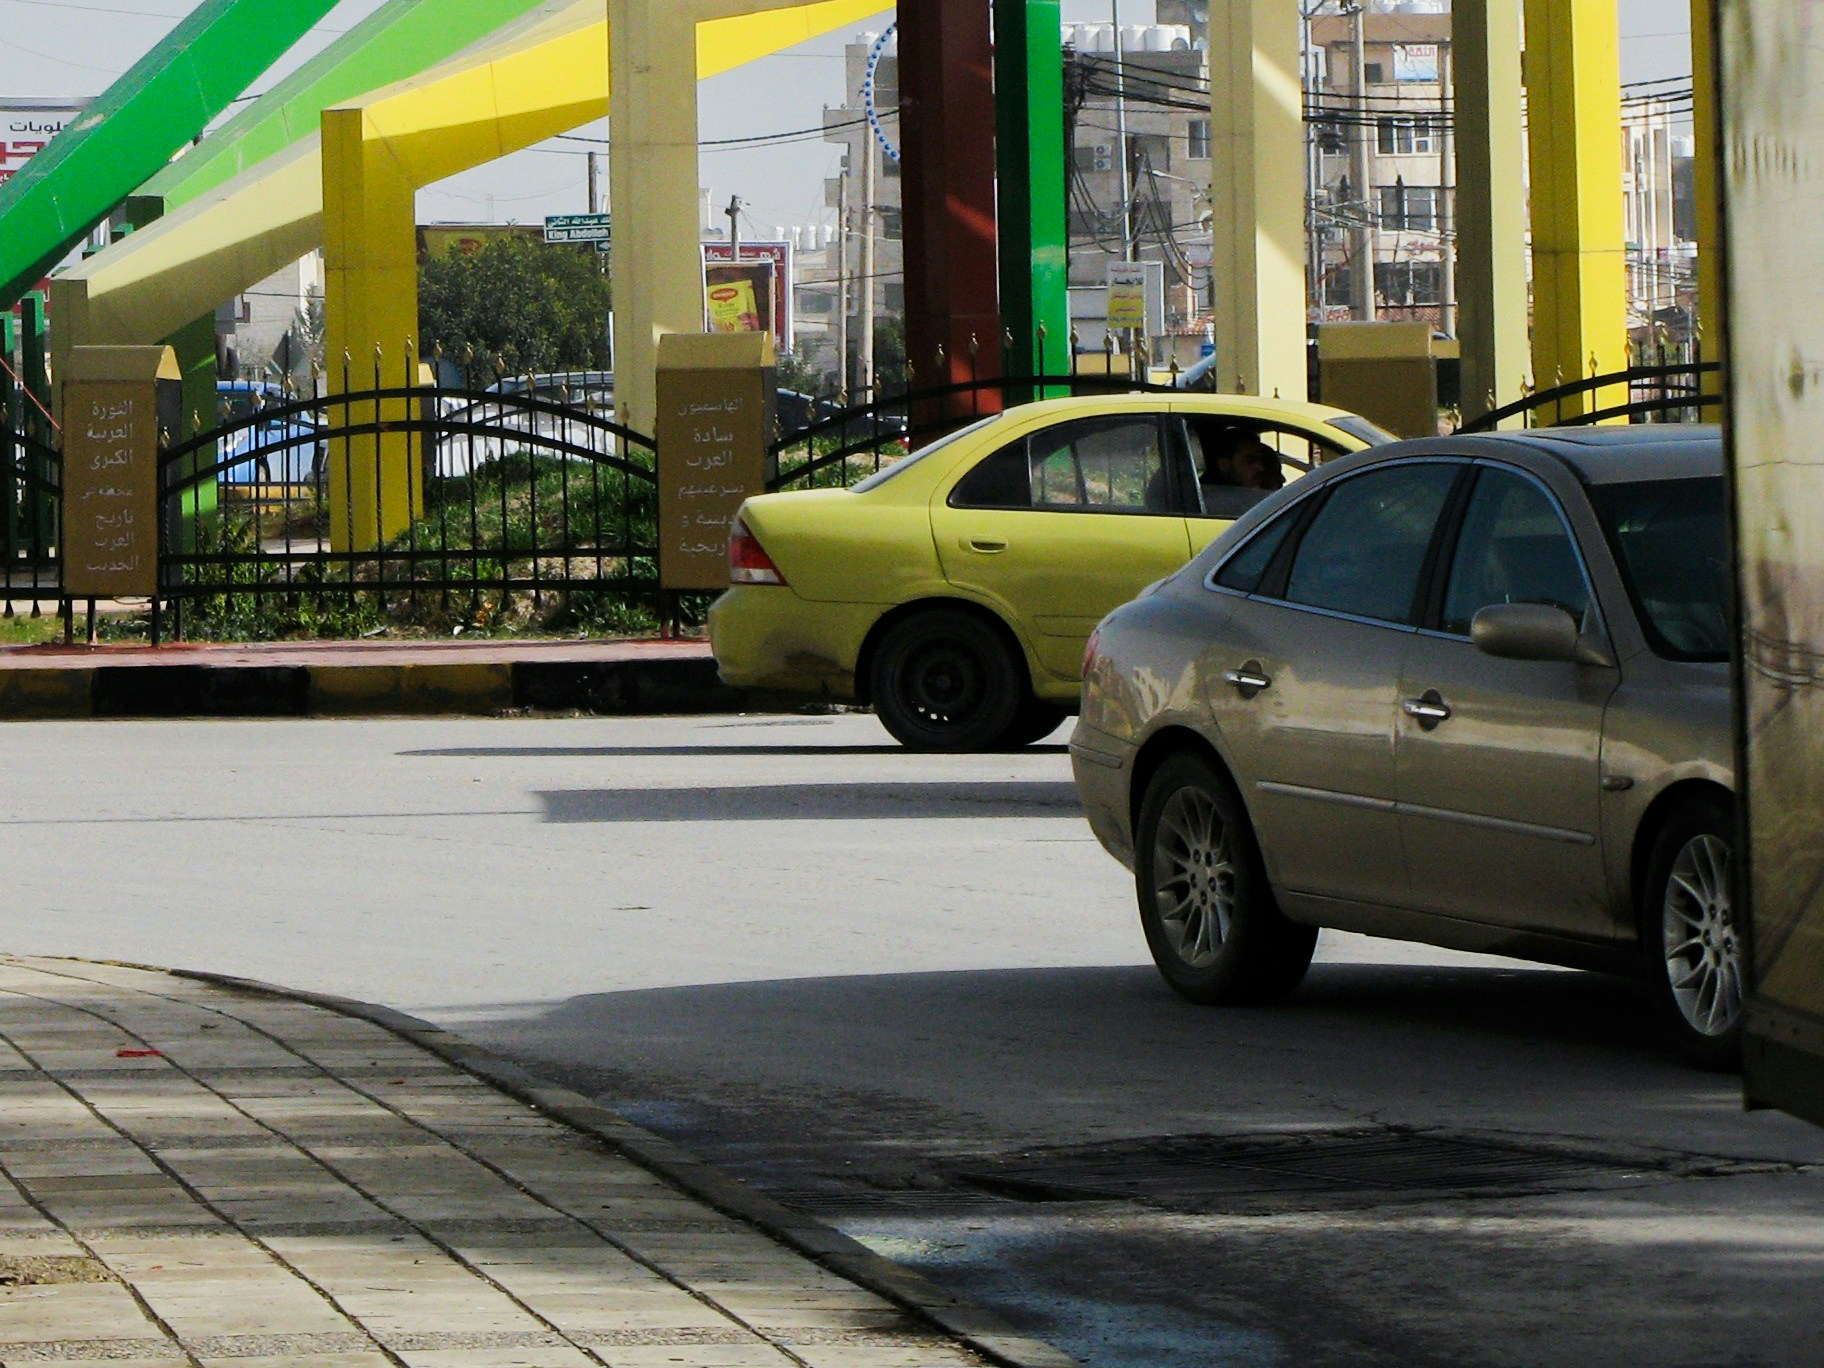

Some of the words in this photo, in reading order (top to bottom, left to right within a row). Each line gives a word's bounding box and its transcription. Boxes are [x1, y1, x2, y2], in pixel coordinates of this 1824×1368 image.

[9, 120, 69, 135] لويات
[92, 399, 133, 420] الثورة
[87, 422, 133, 443] العربية
[693, 425, 734, 444] سادة
[686, 449, 733, 471] العرب
[95, 509, 134, 530] تاريخ
[94, 532, 135, 552] العرب
[86, 555, 139, 572] الحديث
